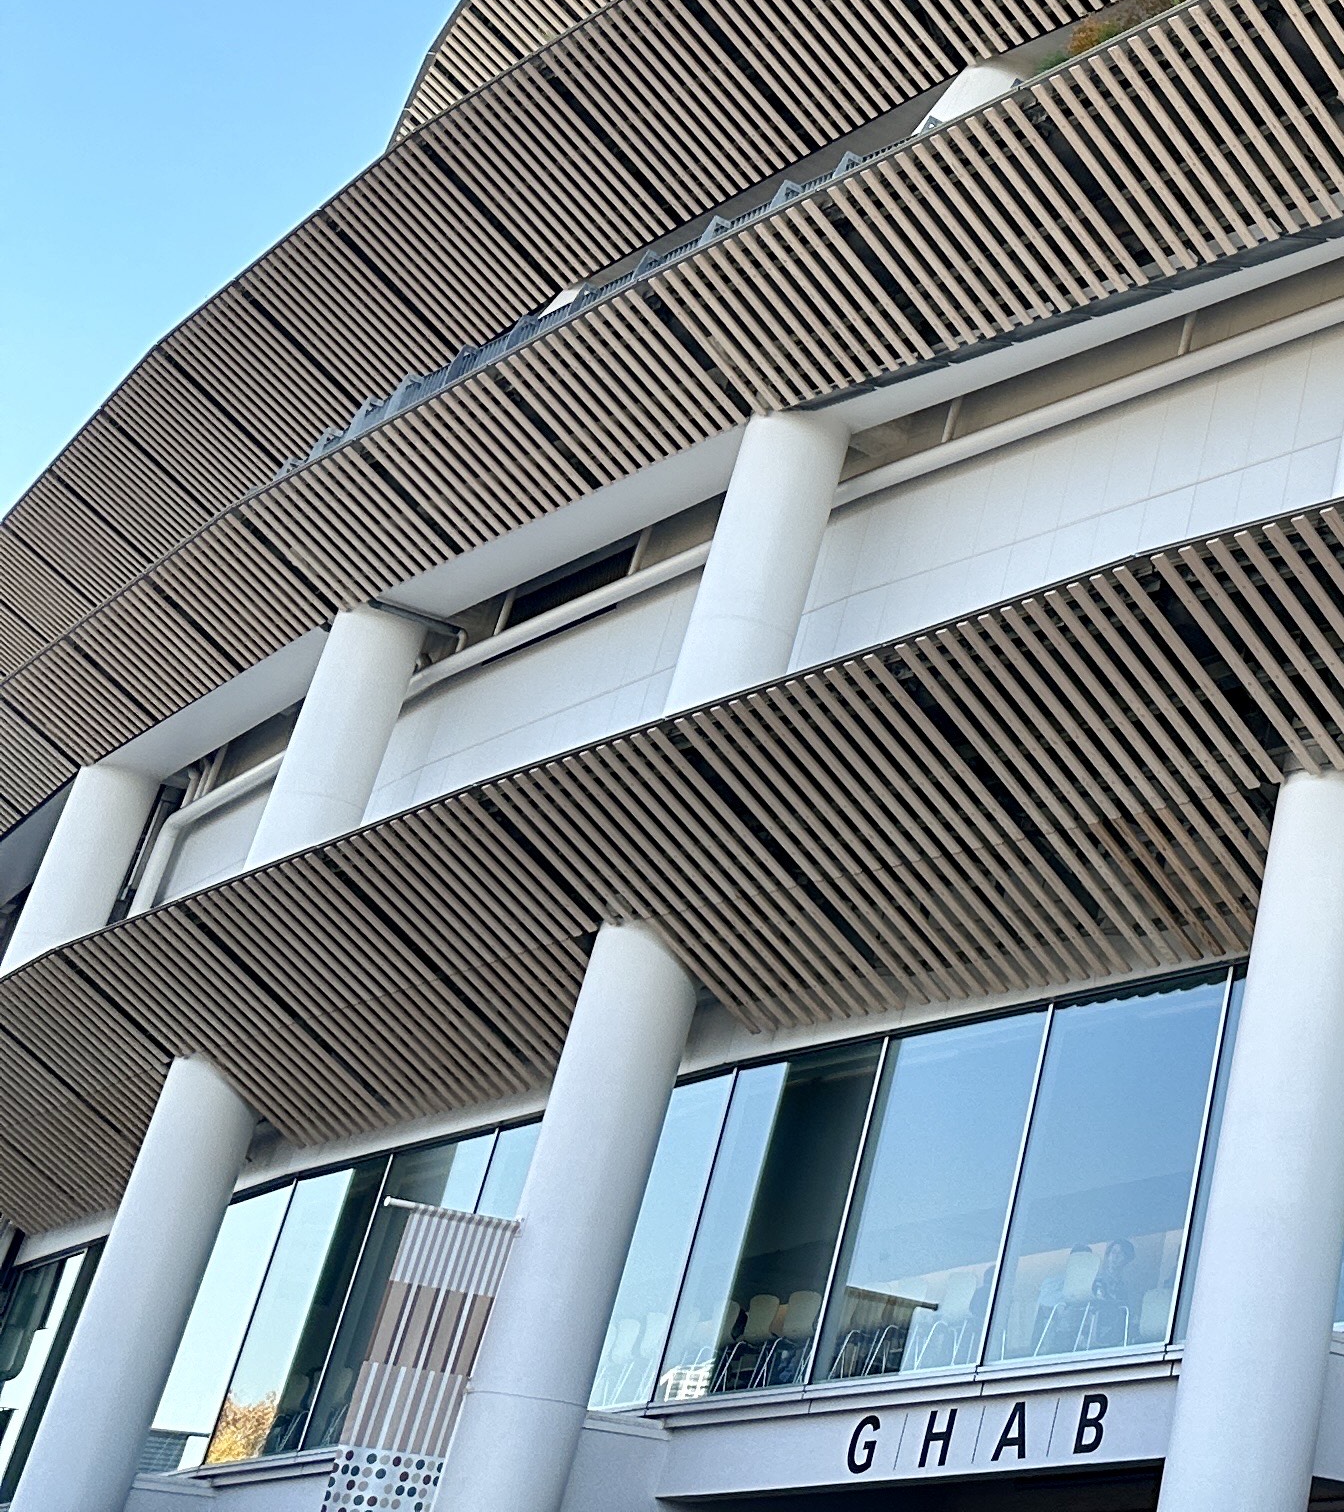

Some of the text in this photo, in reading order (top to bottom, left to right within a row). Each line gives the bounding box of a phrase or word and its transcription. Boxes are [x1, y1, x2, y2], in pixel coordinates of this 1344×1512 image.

[847, 1394, 1109, 1475] G H A B
